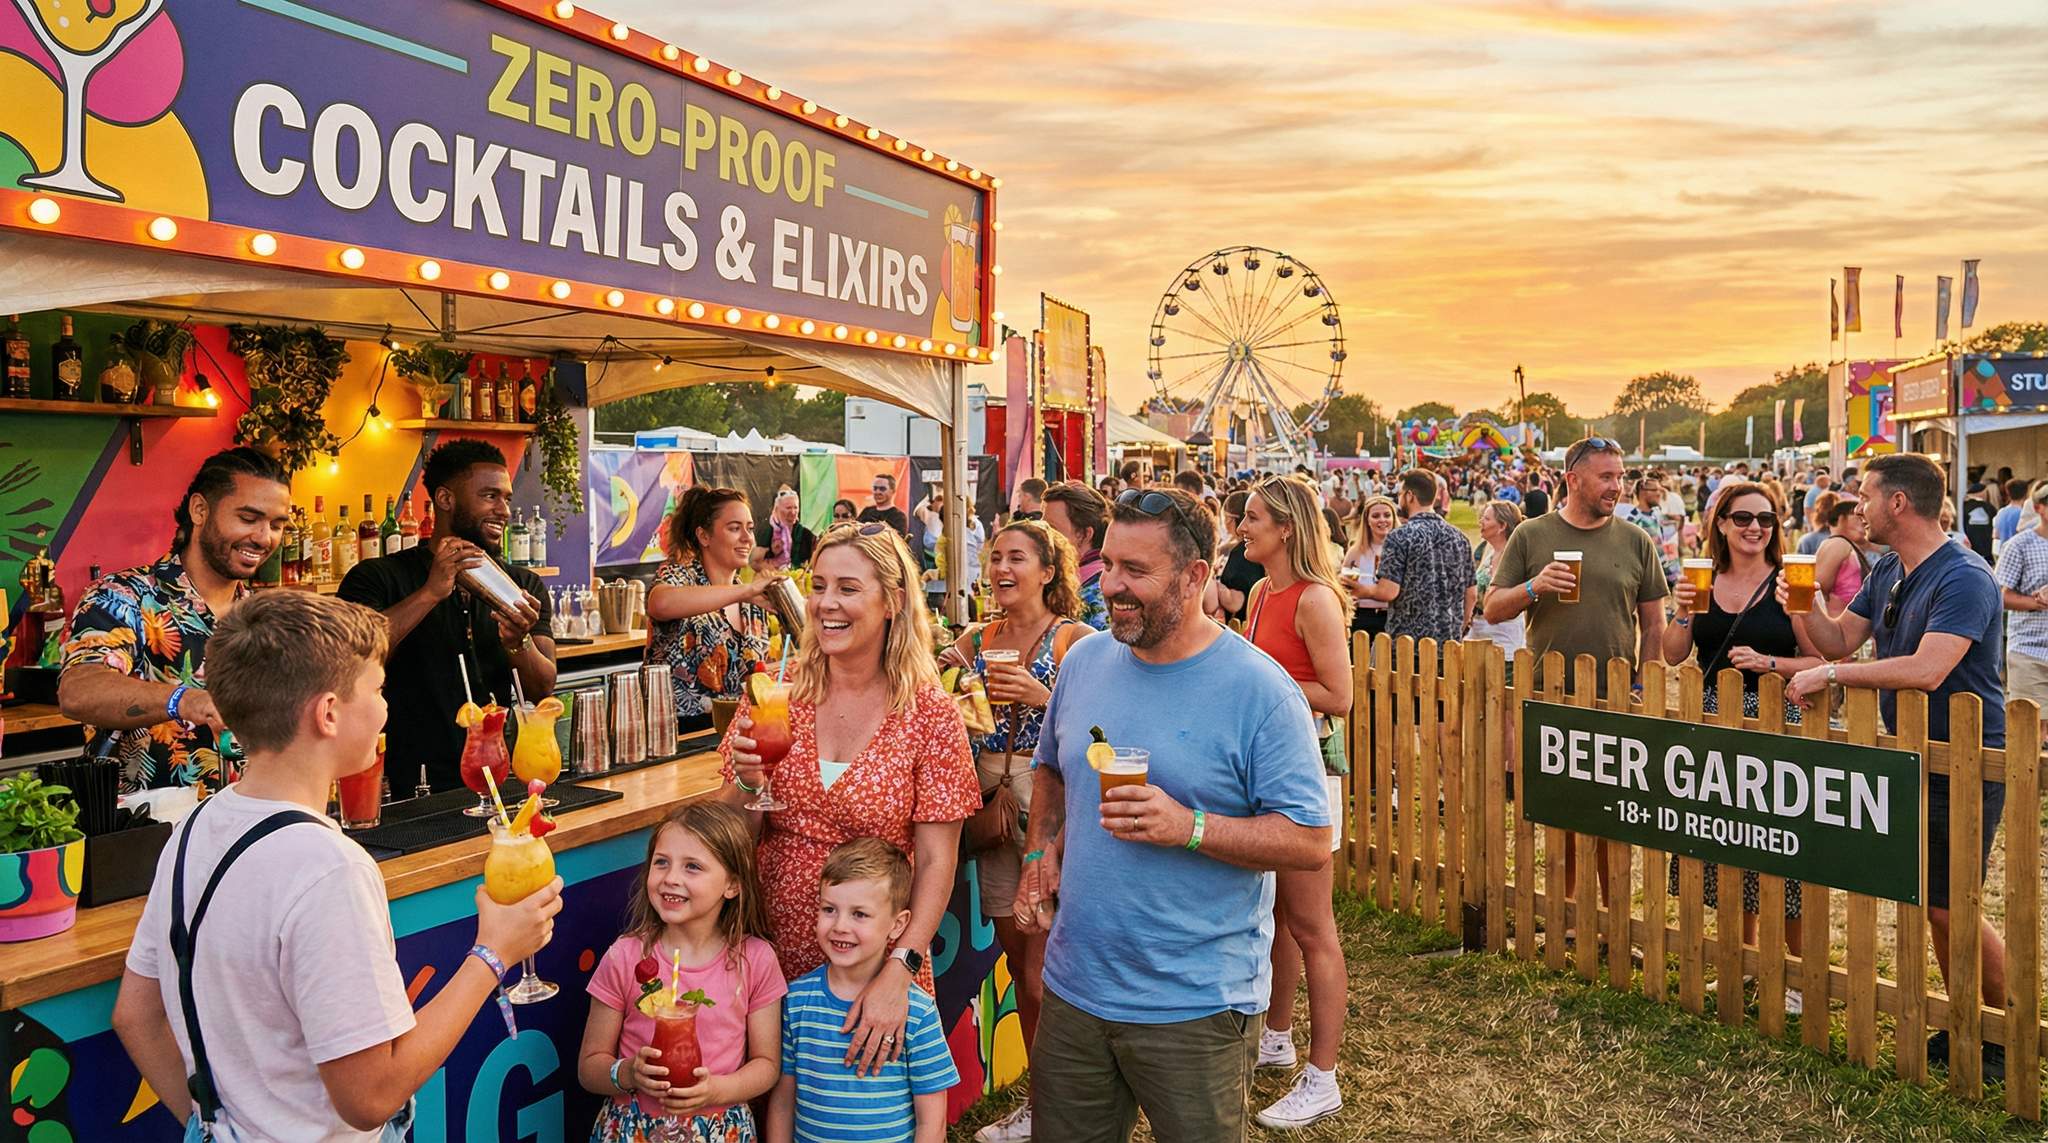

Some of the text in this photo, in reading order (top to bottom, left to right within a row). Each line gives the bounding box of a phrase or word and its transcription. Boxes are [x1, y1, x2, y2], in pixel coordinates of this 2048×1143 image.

[487, 33, 838, 209] ZERO-PROOF
[233, 83, 929, 317] COCKTAILS & ELIXIRS
[1540, 724, 1889, 836] BEER GARDEN
[1617, 799, 1652, 825] 18+
[1657, 806, 1679, 833] ID
[1685, 812, 1800, 857] REQUIRED
